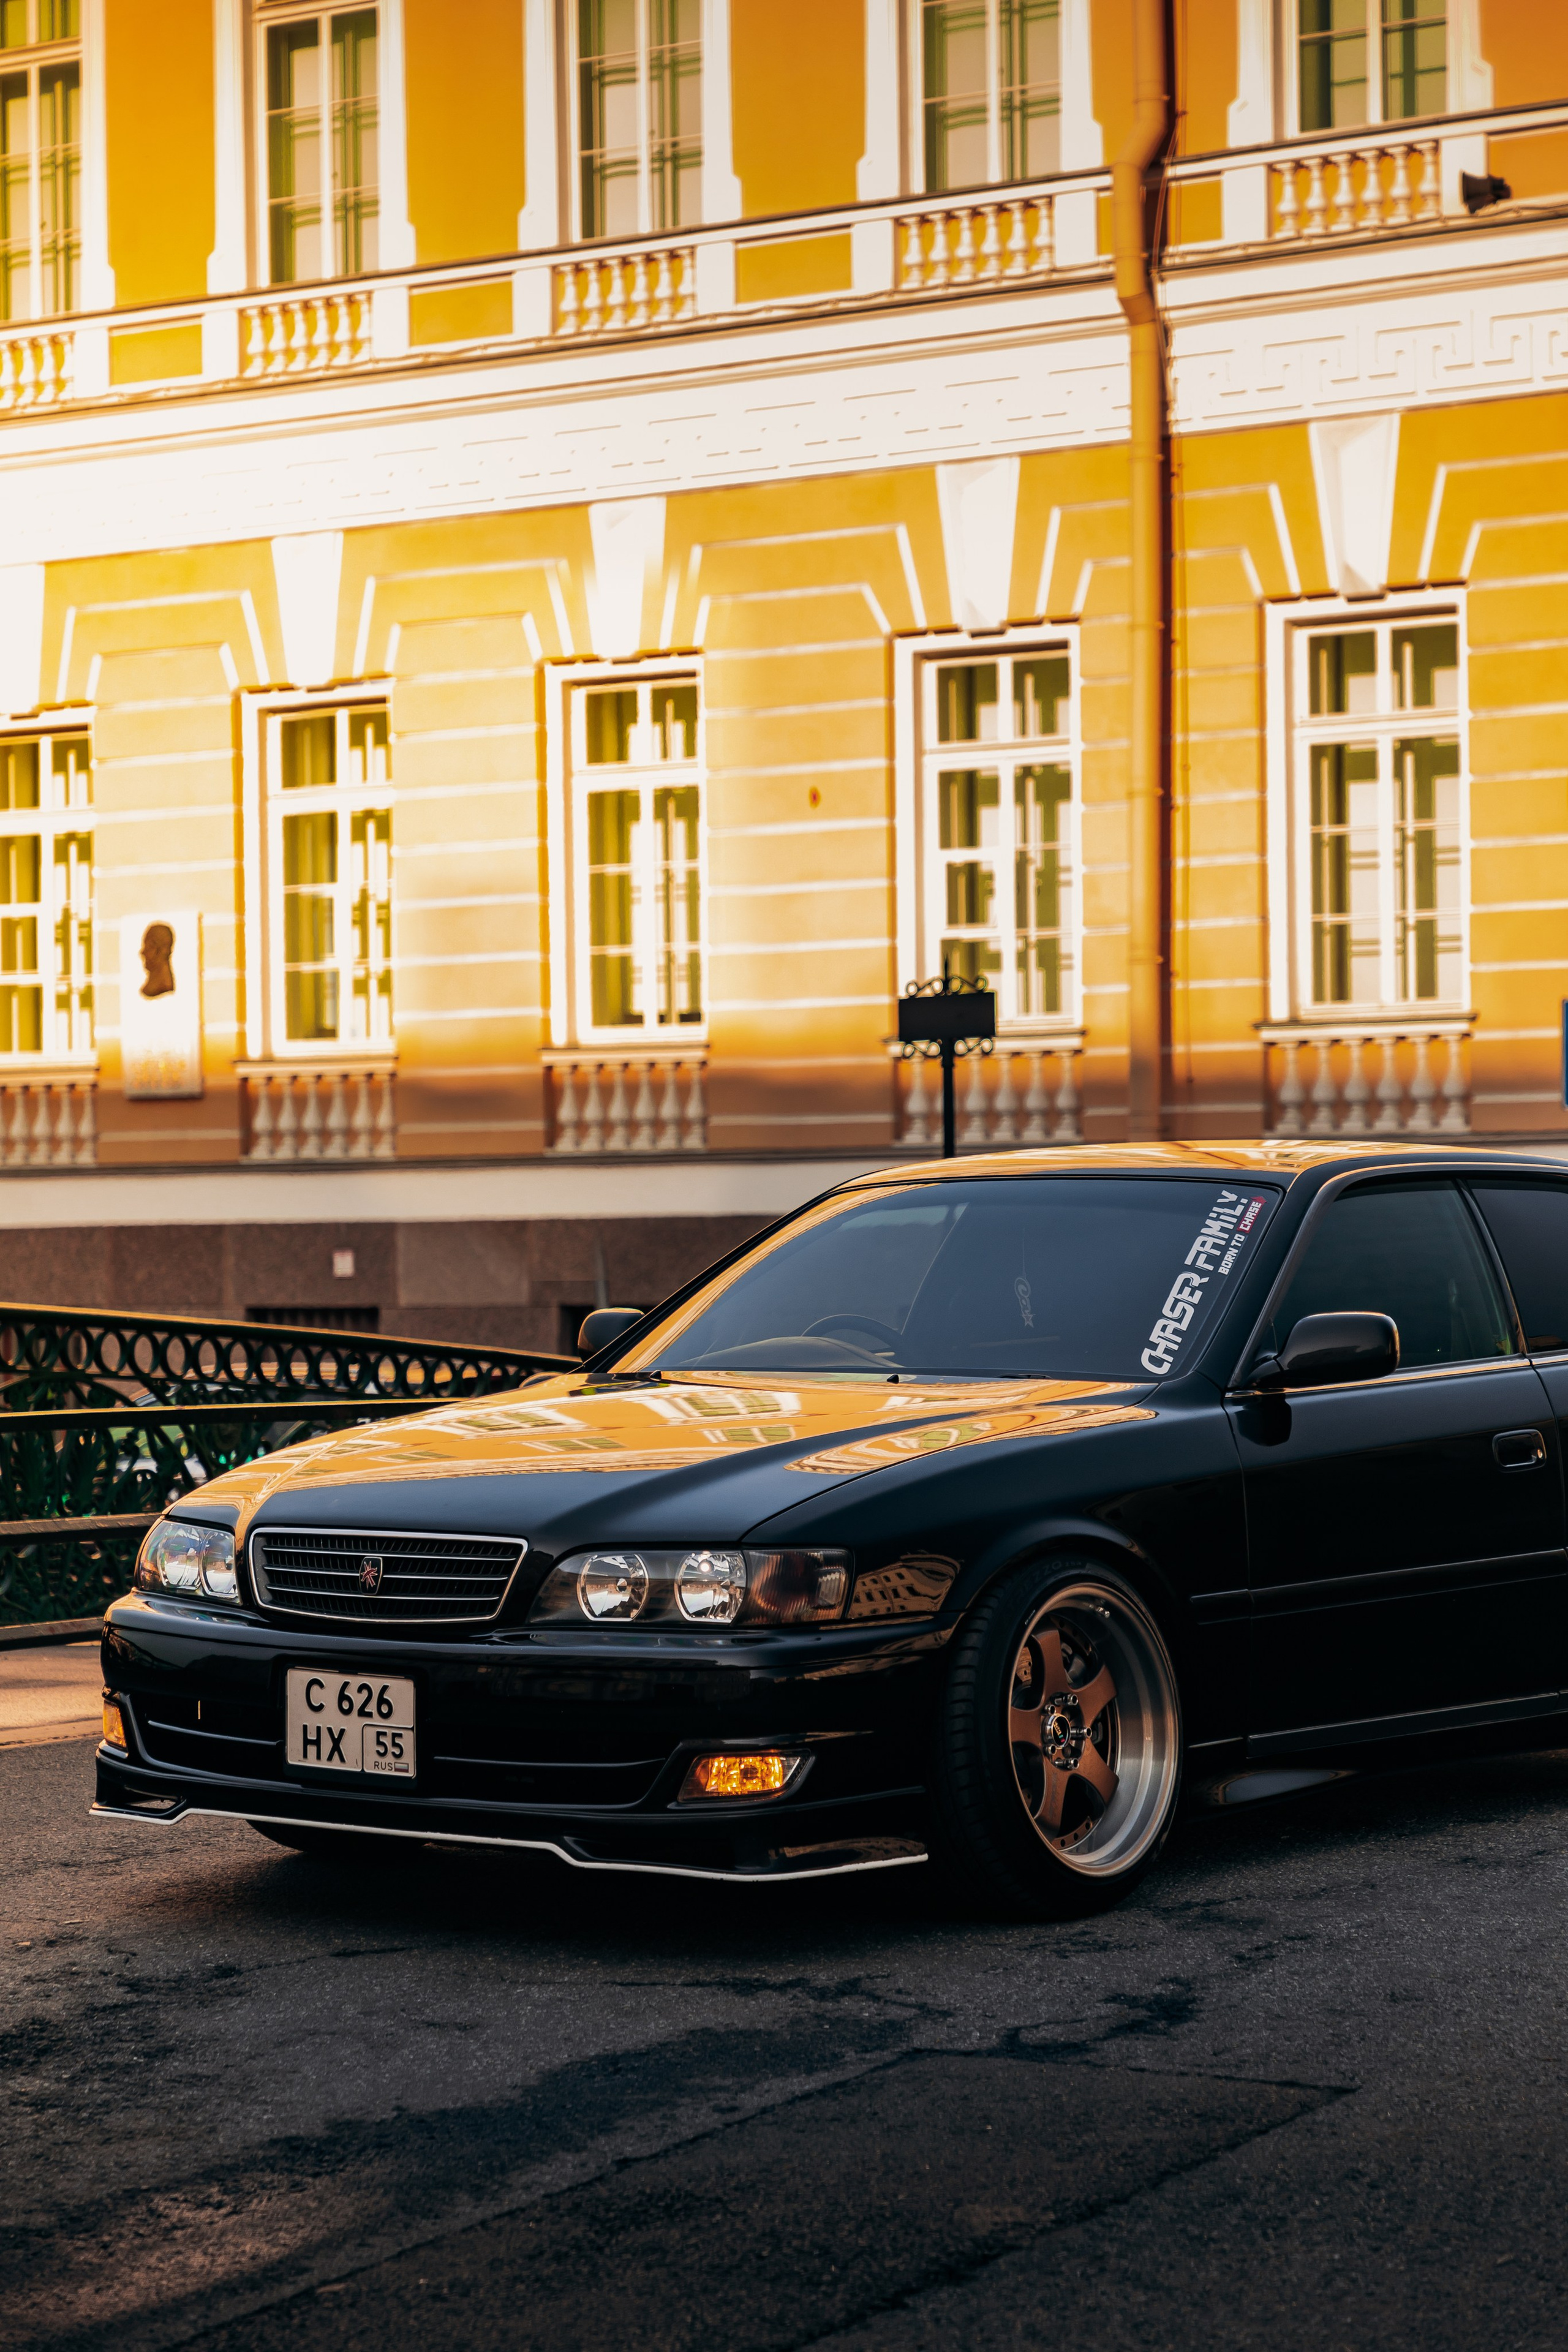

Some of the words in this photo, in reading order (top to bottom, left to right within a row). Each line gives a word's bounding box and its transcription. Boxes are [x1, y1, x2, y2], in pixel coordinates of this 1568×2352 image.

[1218, 1247, 1238, 1275] BORN
[1231, 1234, 1245, 1247] TO
[1239, 1201, 1262, 1232] CHASE
[1140, 1271, 1210, 1374] CHASER
[337, 1681, 393, 1719] 626
[302, 1724, 347, 1763] HX
[375, 1730, 404, 1759] 55
[374, 1761, 393, 1771] RUS
